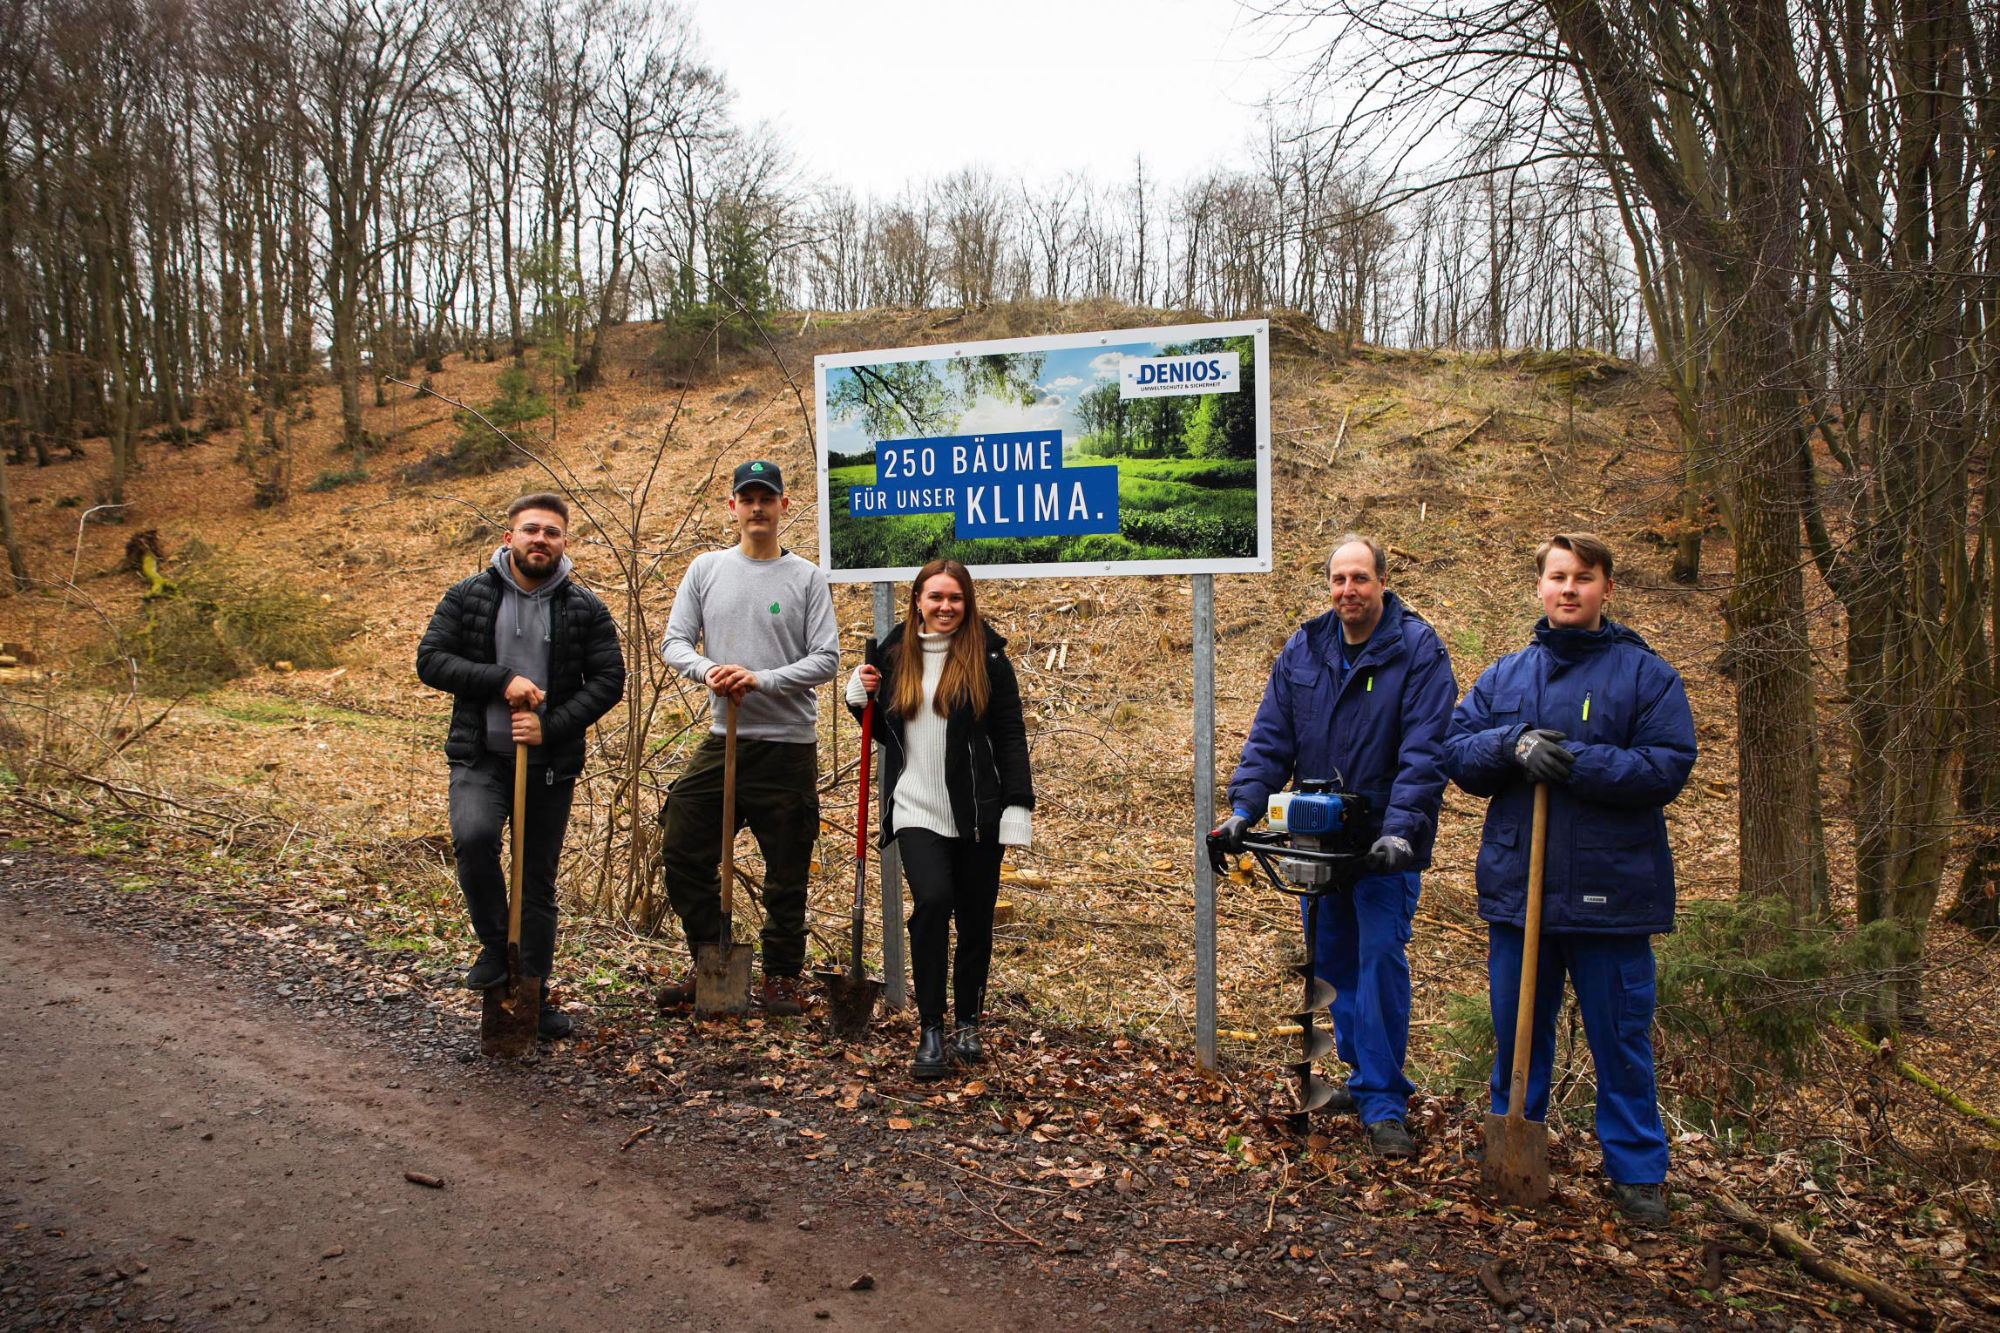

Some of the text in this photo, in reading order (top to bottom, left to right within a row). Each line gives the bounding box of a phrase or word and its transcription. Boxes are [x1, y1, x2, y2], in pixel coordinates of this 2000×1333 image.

[884, 437, 1052, 478] 250 BÄUME
[854, 481, 1104, 525] FÜR UNSER KLIMA.
